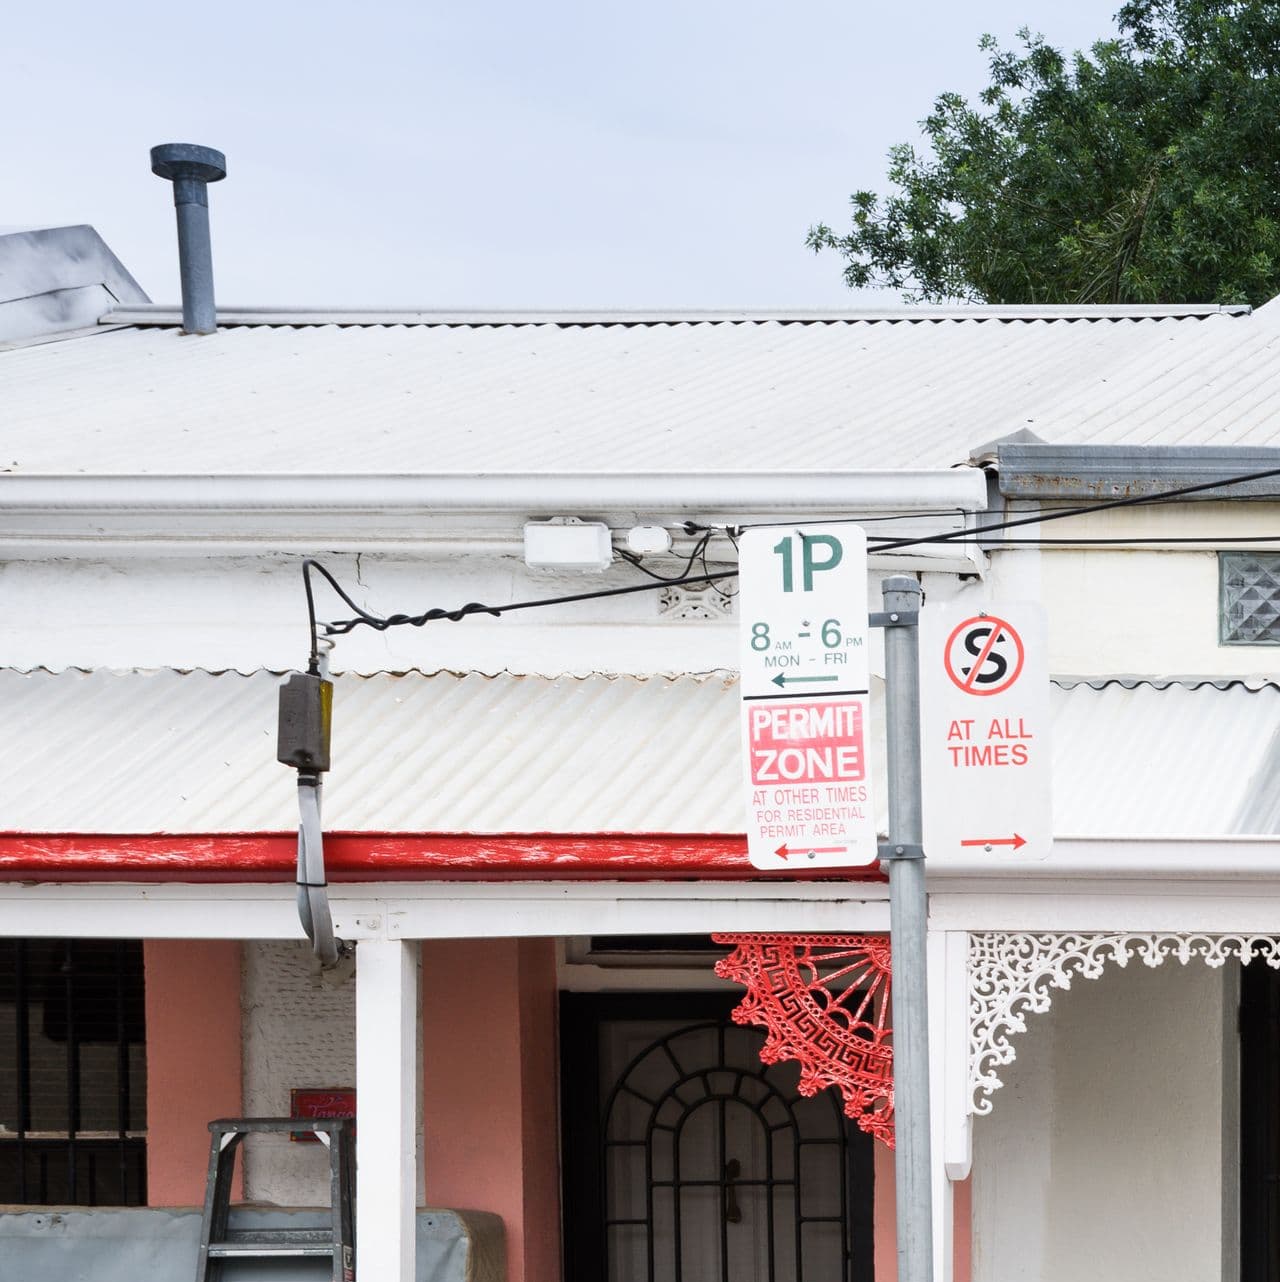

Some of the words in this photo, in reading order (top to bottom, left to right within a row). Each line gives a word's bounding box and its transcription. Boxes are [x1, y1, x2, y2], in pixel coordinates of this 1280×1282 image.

[773, 534, 843, 592] 1P
[764, 654, 800, 667] MON
[824, 652, 848, 665] FRI
[753, 705, 858, 741] PERMIT
[947, 720, 975, 741] AT
[988, 718, 1033, 740] ALL
[755, 746, 860, 781] ZONE
[948, 744, 1028, 767] TIMES
[753, 790, 767, 805] AT
[774, 788, 819, 805] OTHER
[826, 786, 867, 802] TIMES
[757, 810, 781, 823] FOR
[788, 807, 865, 821] RESIDENTIAL
[760, 825, 806, 838] PERMIT
[813, 823, 846, 836] AREA
